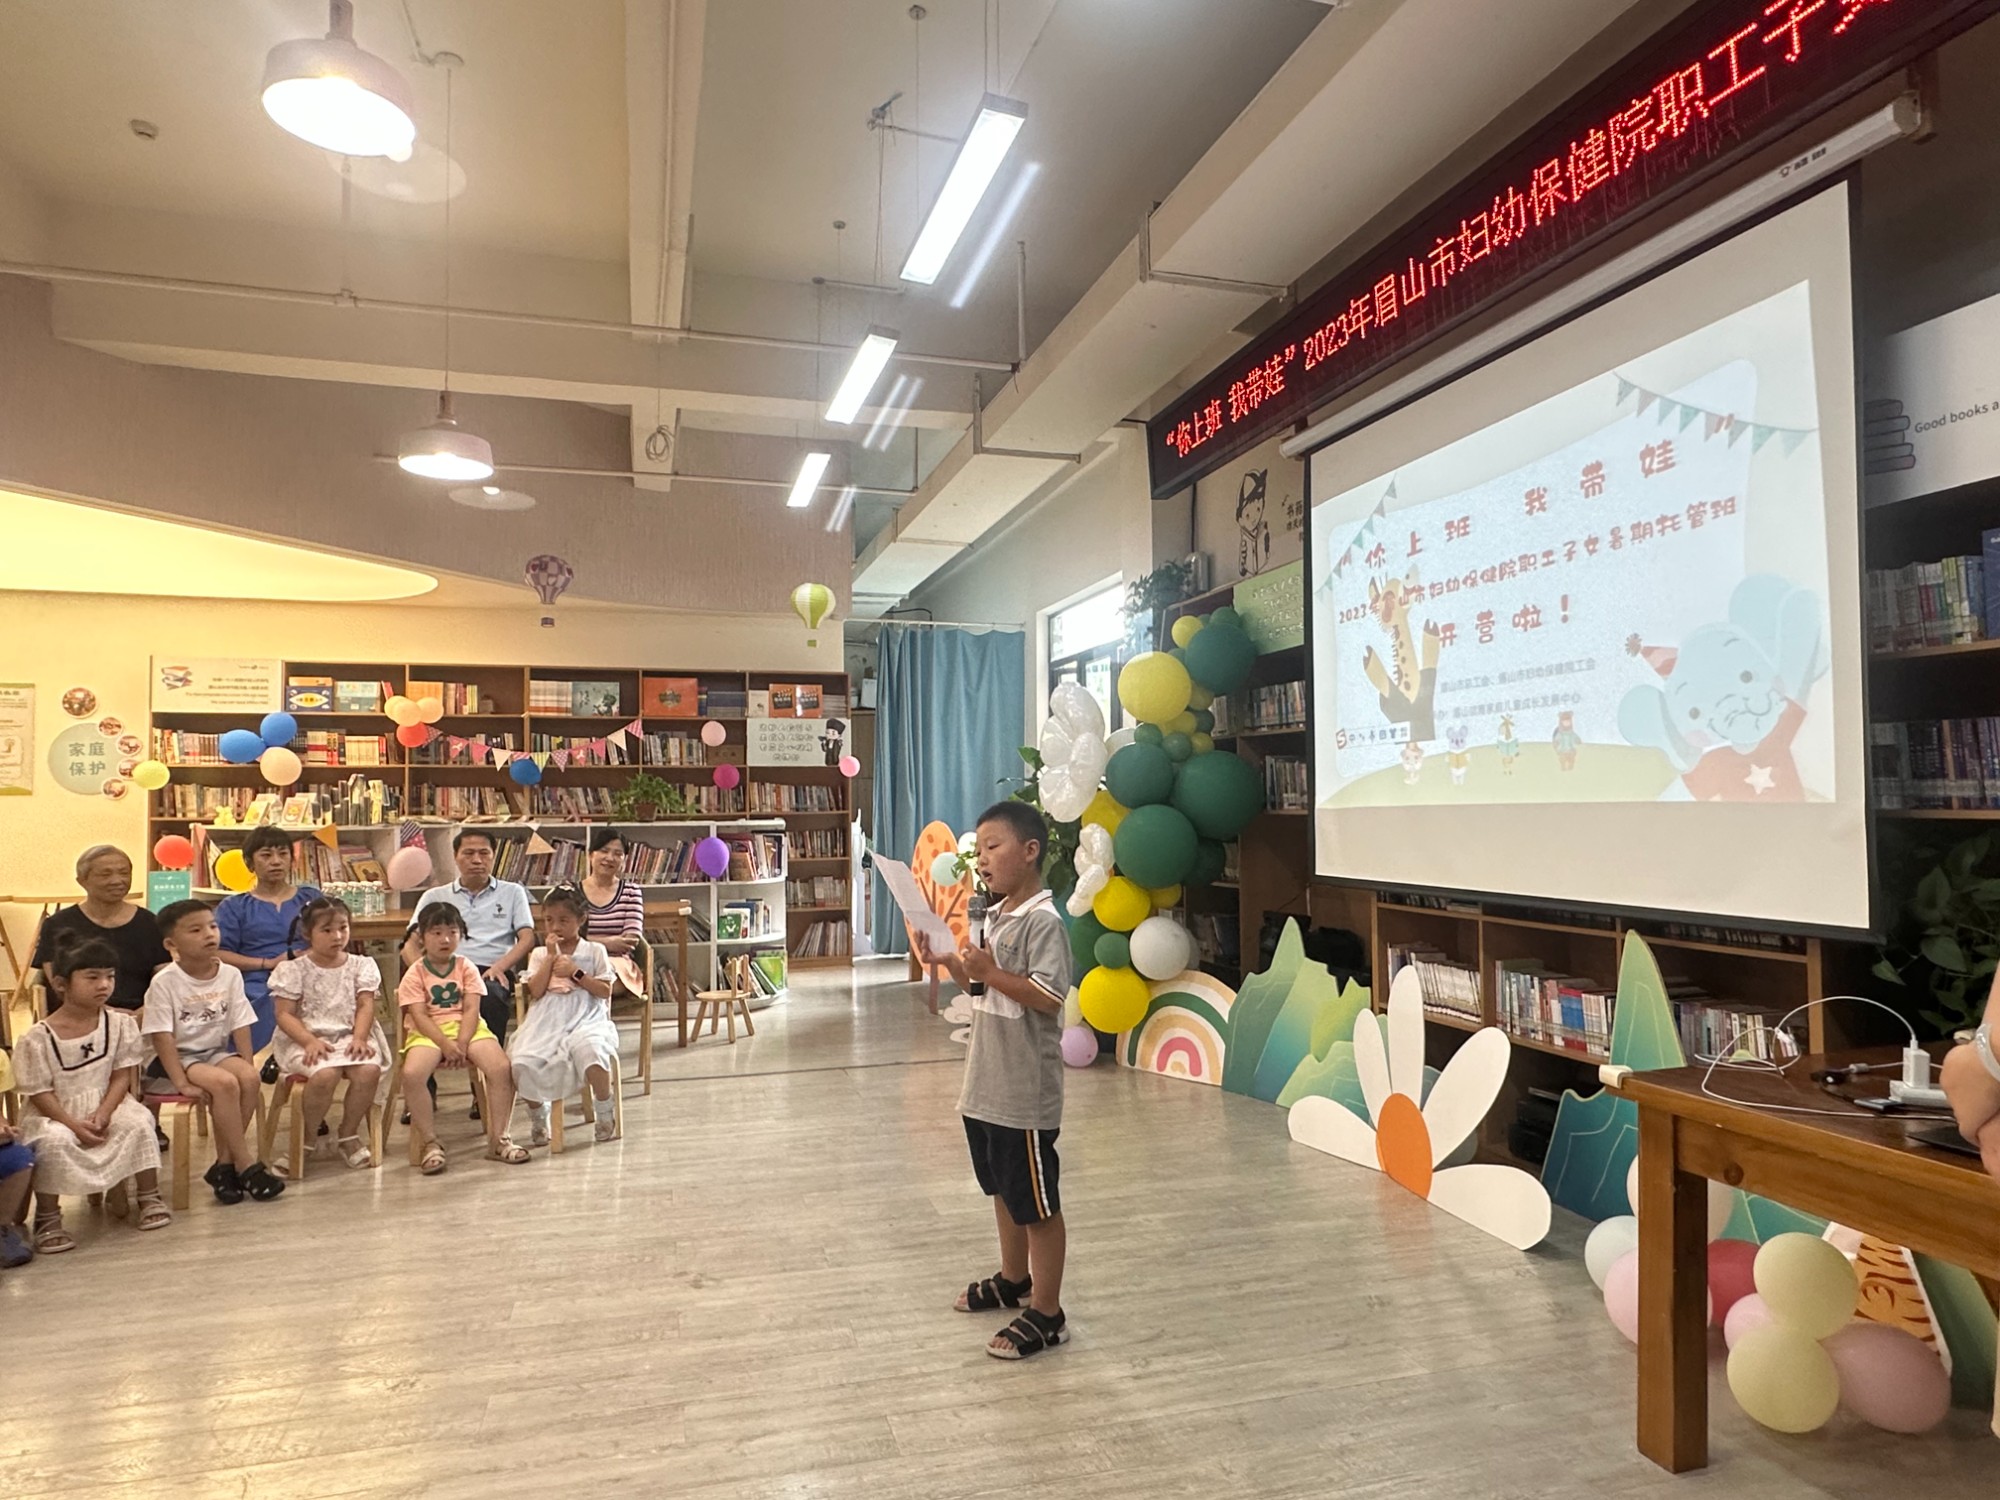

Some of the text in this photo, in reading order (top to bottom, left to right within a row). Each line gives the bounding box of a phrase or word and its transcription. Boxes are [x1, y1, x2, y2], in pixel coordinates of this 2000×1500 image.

[1166, 0, 1892, 458] “你上班 我带娃” 2023年眉山市妇幼保健院职工子
[1914, 414, 1946, 433] Good
[1950, 404, 1988, 423] books
[1339, 496, 1737, 624] 2023年山市妇幼保健院职工子女暑期托管班
[68, 742, 105, 757] 家庭
[69, 761, 106, 776] 保护
